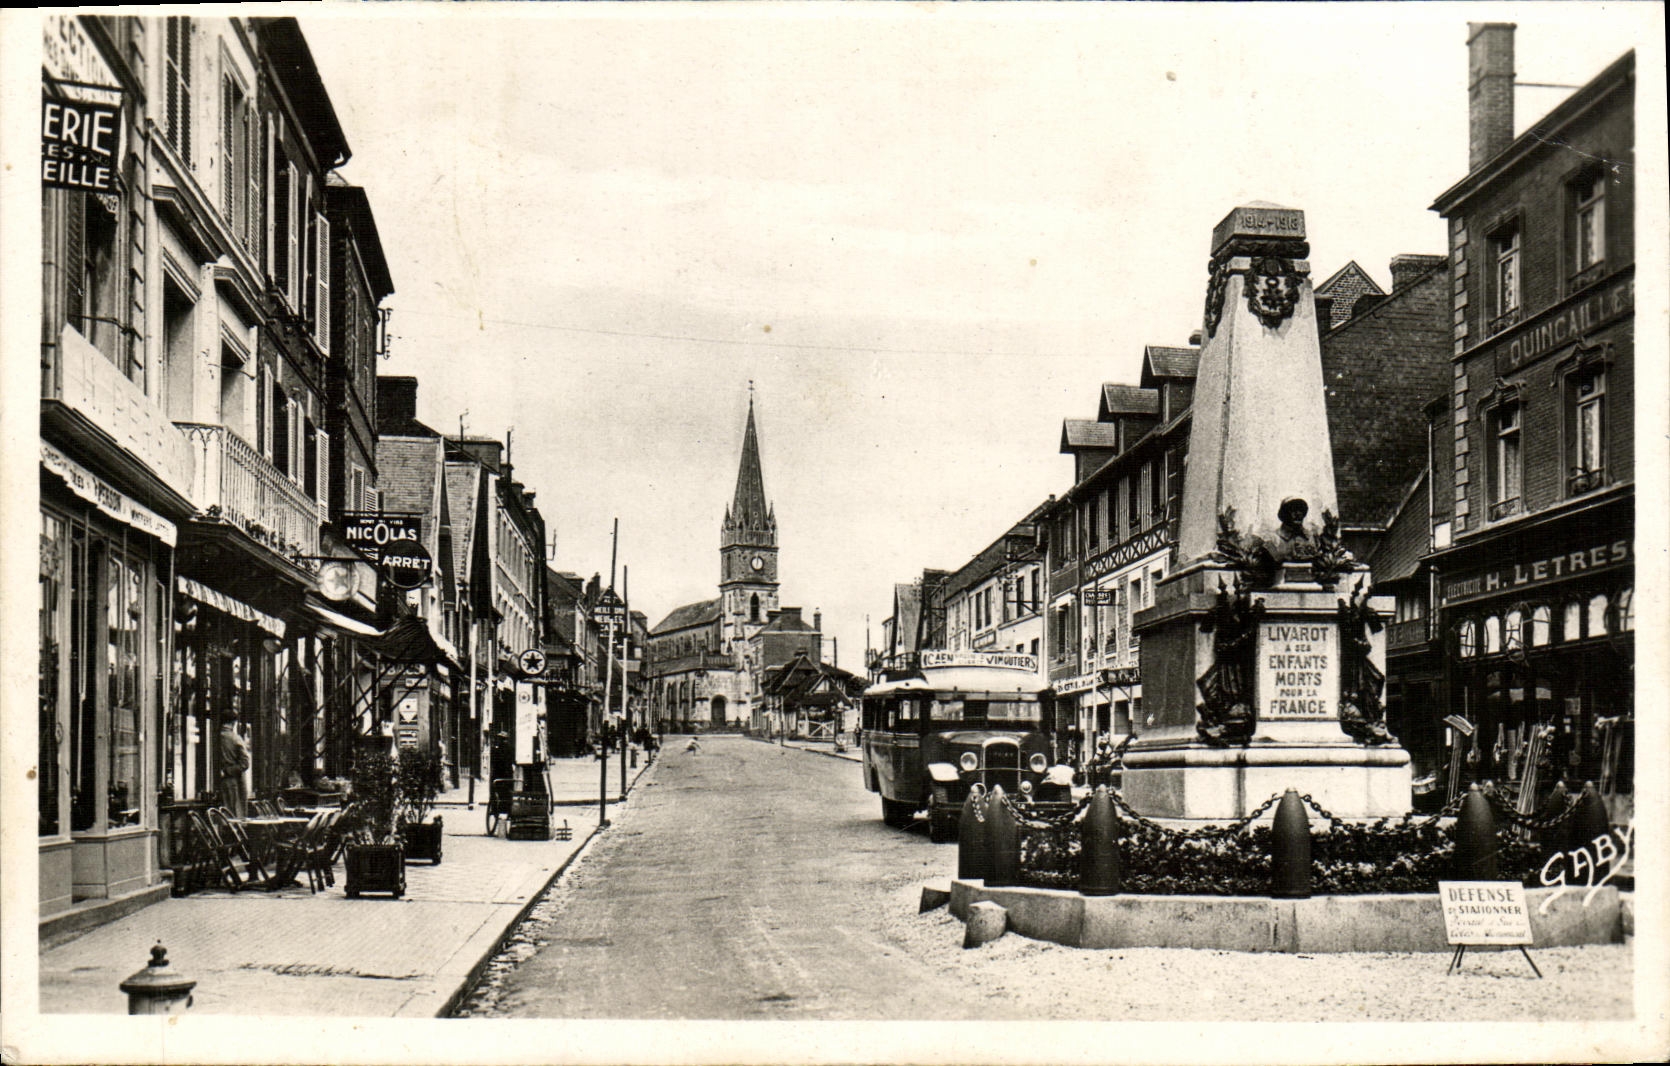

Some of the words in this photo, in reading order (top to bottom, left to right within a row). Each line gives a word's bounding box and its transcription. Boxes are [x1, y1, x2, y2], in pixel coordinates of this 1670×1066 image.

[43, 103, 114, 157] ERIE
[43, 160, 111, 189] EILLE
[346, 523, 418, 545] NICOLAS
[1486, 571, 1508, 591] H.
[1514, 540, 1627, 585] LETRES
[1267, 626, 1329, 642] LIVAROT
[1269, 655, 1329, 670] ENFANTS
[1275, 672, 1322, 687] MORTS
[1280, 689, 1303, 698] POUR
[1306, 690, 1318, 698] LA
[1270, 700, 1327, 715] FRANCE
[1448, 887, 1515, 902] DEFENSE
[1458, 905, 1522, 915] STATIONNER
